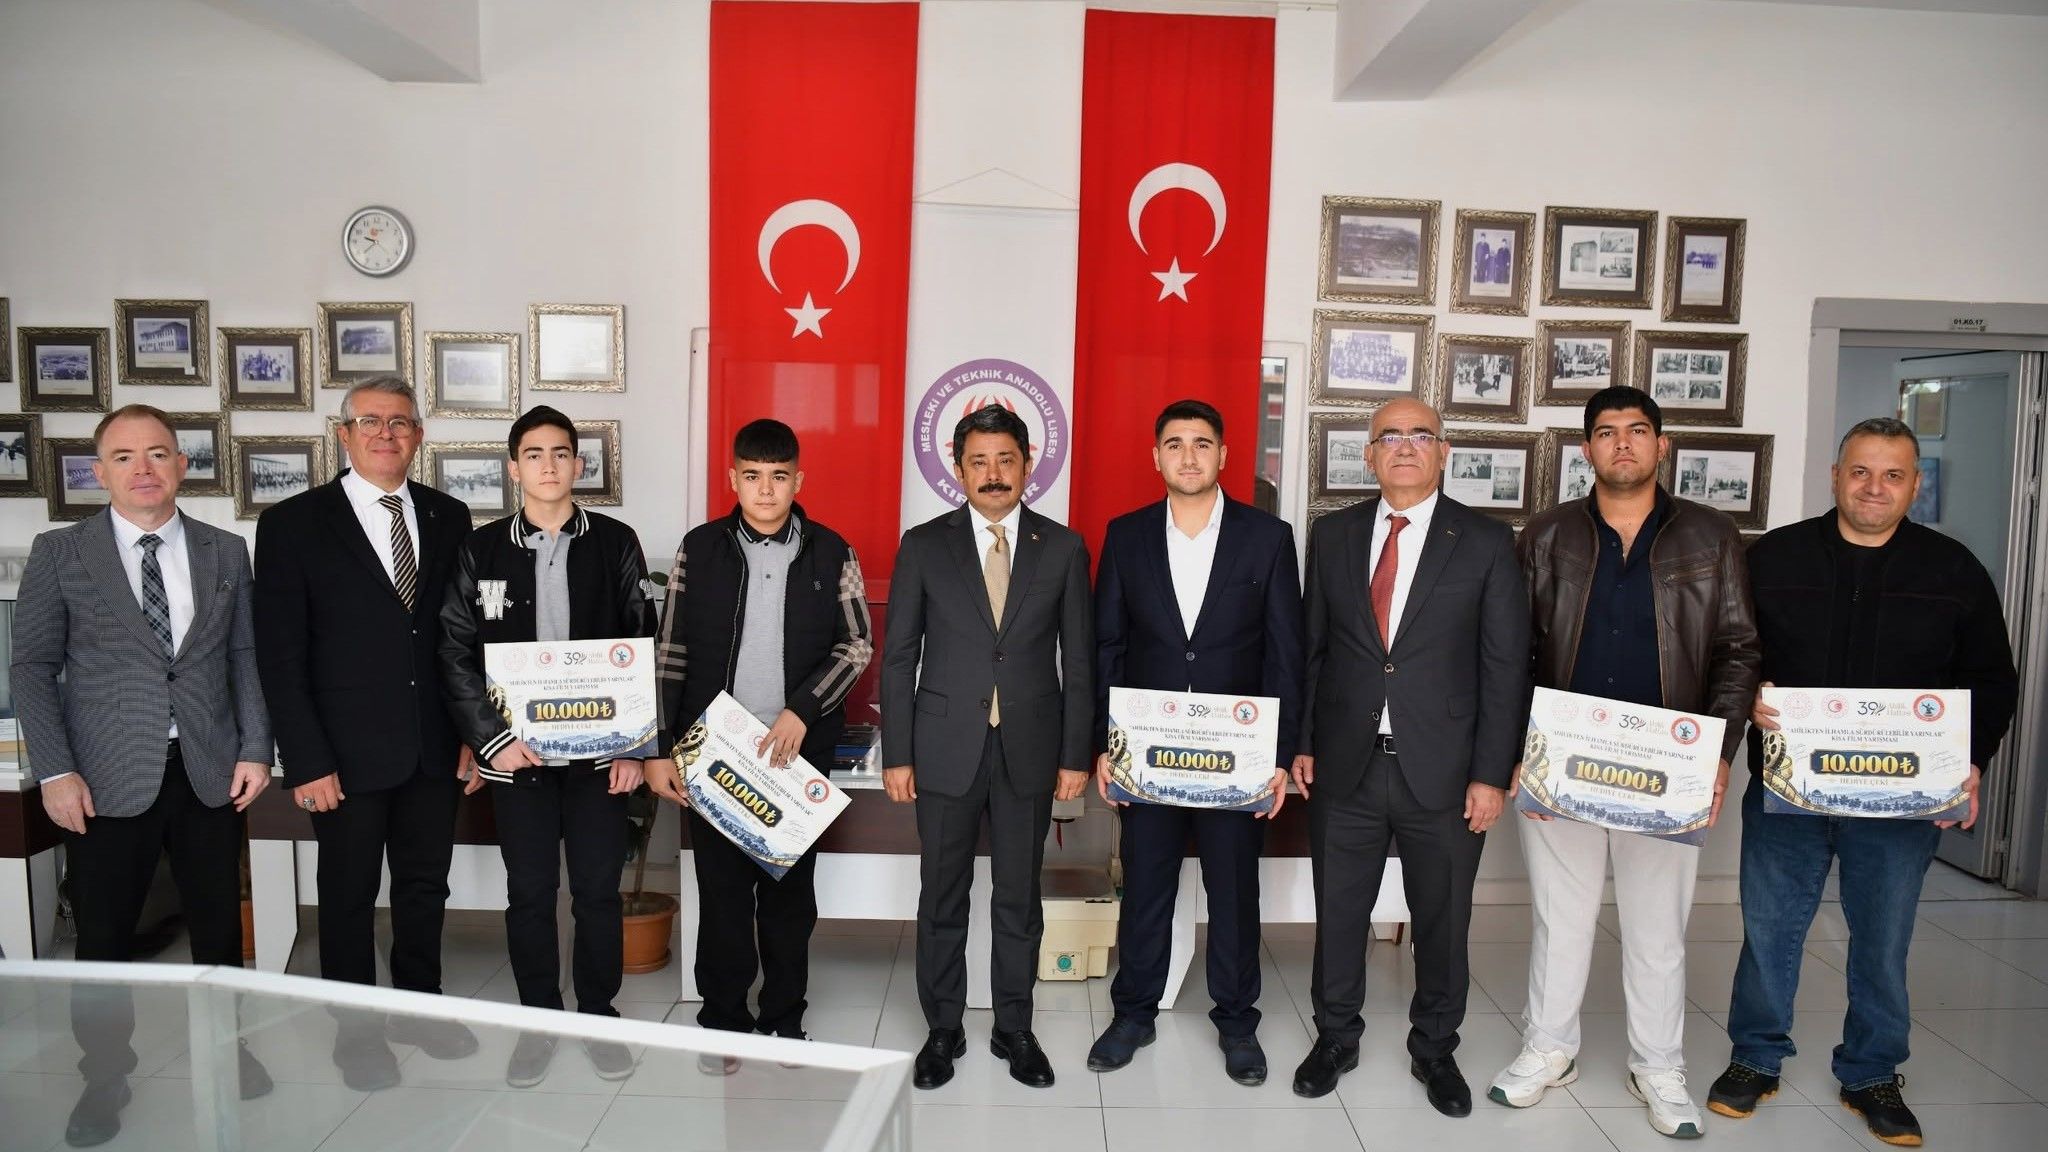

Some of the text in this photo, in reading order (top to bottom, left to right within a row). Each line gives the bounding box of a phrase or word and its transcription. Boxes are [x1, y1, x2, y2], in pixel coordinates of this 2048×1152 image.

[936, 384, 954, 398] VE
[1005, 373, 1054, 417] ANADOLU
[478, 580, 507, 620] W
